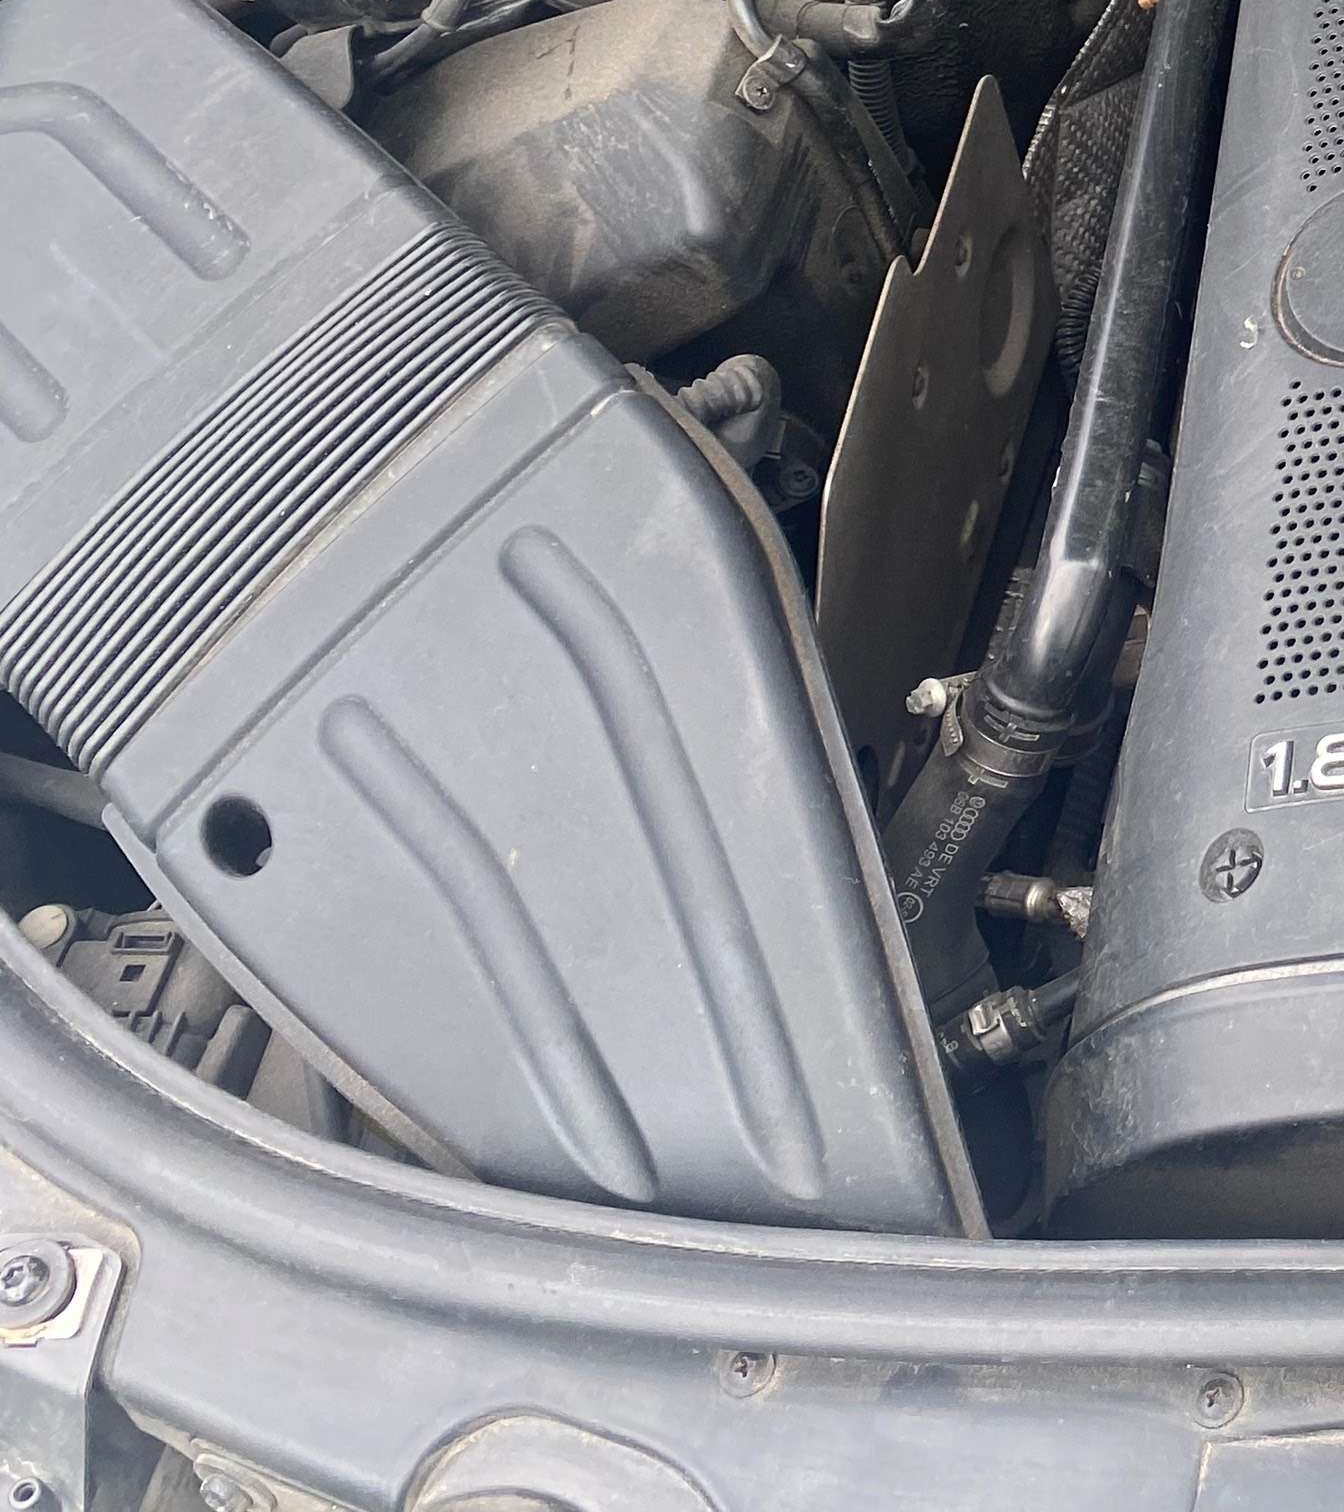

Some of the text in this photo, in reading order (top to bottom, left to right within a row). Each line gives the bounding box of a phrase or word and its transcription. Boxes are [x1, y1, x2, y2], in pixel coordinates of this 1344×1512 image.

[935, 818, 954, 841] 103
[918, 841, 939, 868] 493
[905, 866, 923, 889] AE
[920, 842, 959, 898] DE VRT
